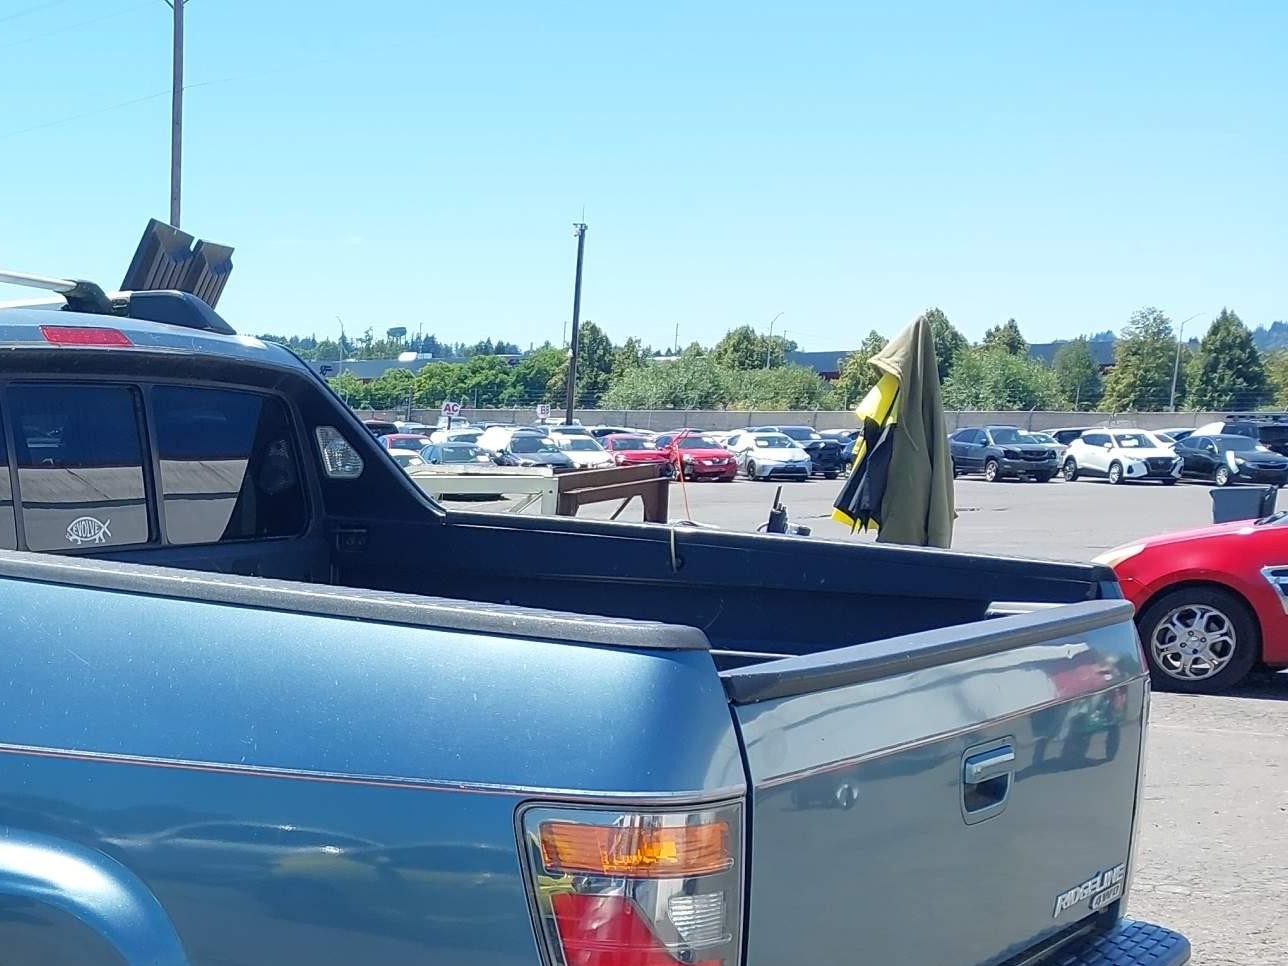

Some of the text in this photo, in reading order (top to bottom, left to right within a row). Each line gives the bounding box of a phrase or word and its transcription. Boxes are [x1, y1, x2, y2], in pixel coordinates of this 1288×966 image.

[443, 403, 459, 413] AC
[72, 519, 100, 537] EVOLVE
[1052, 862, 1125, 918] RIDGELINE
[1093, 884, 1120, 907] 4WD
